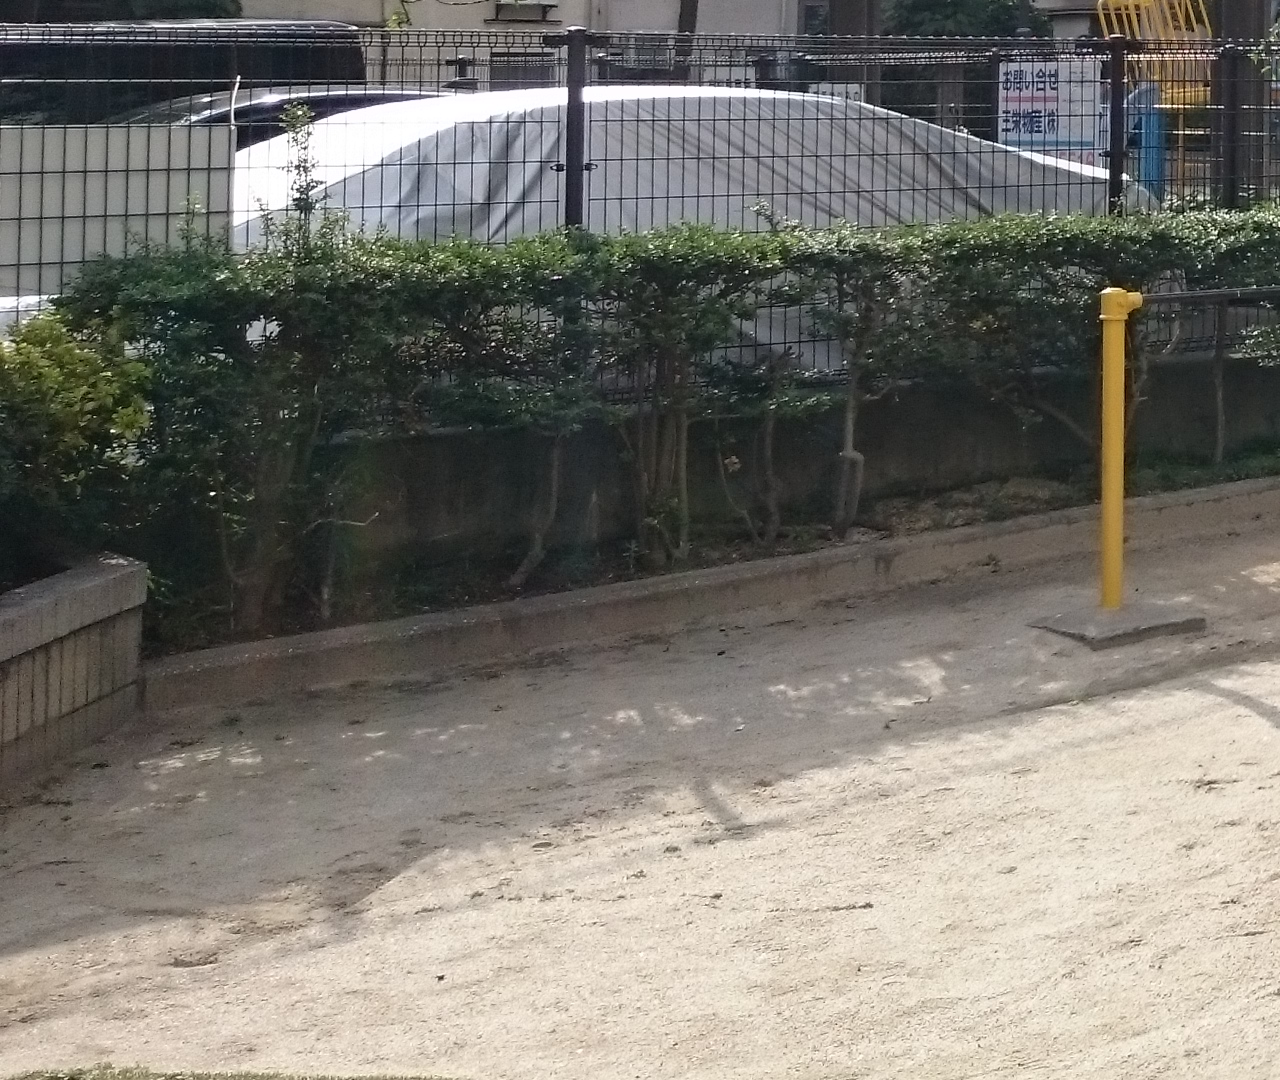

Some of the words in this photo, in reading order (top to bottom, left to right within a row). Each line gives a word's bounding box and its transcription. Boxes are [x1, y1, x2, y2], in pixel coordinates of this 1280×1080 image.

[1002, 68, 1058, 91] お問い合せ
